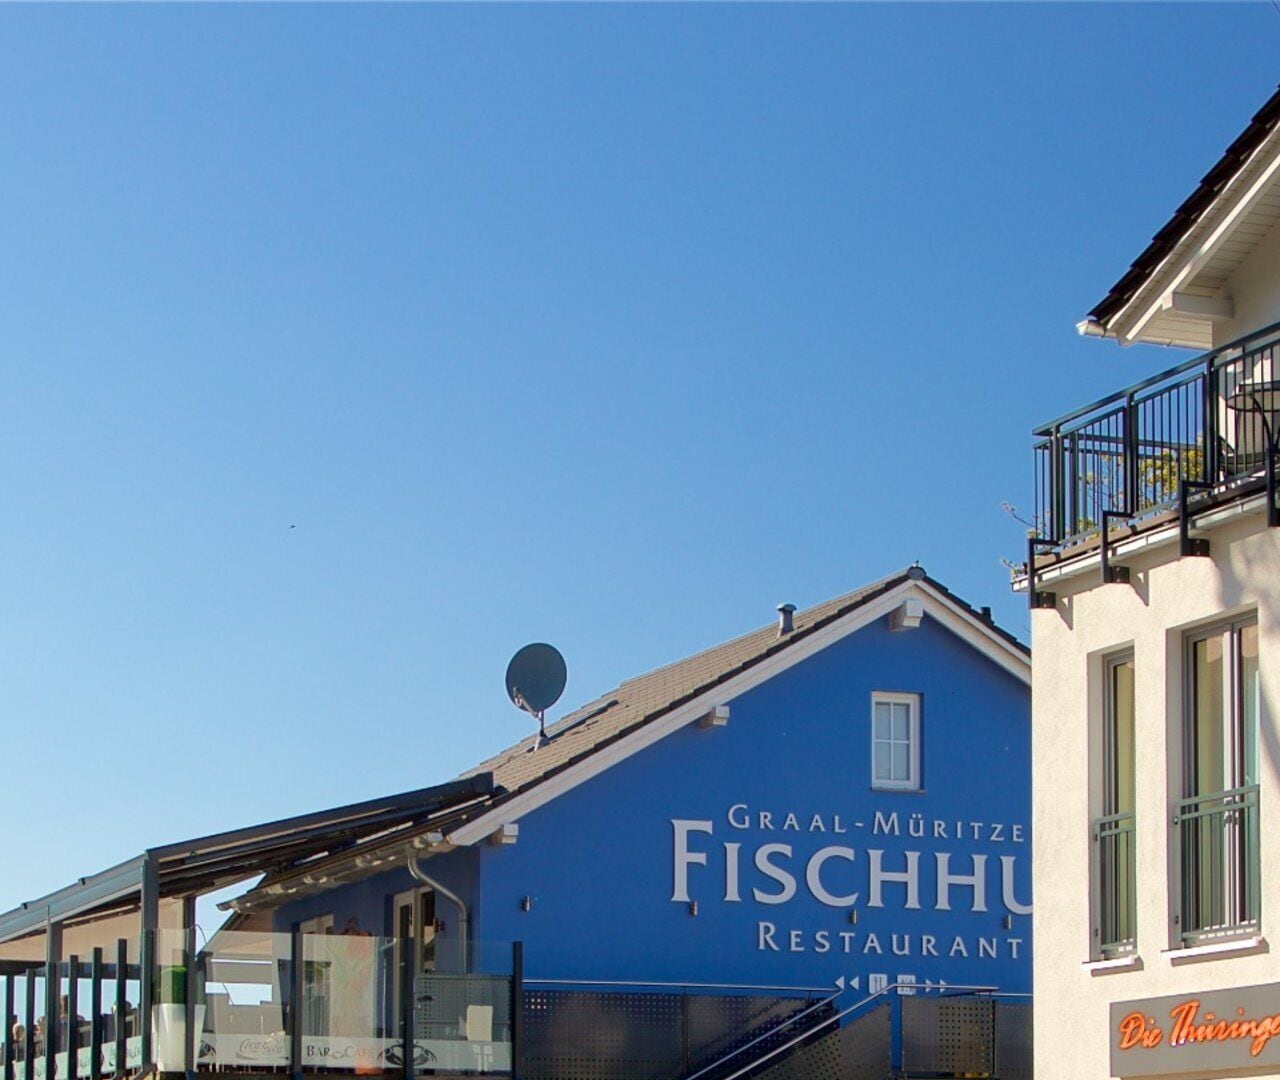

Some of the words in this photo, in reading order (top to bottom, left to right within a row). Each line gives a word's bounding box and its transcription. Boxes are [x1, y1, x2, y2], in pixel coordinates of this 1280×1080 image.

[756, 921, 1023, 959] RESTAURANT
[1118, 1010, 1162, 1051] Die
[306, 1044, 332, 1058] BAR
